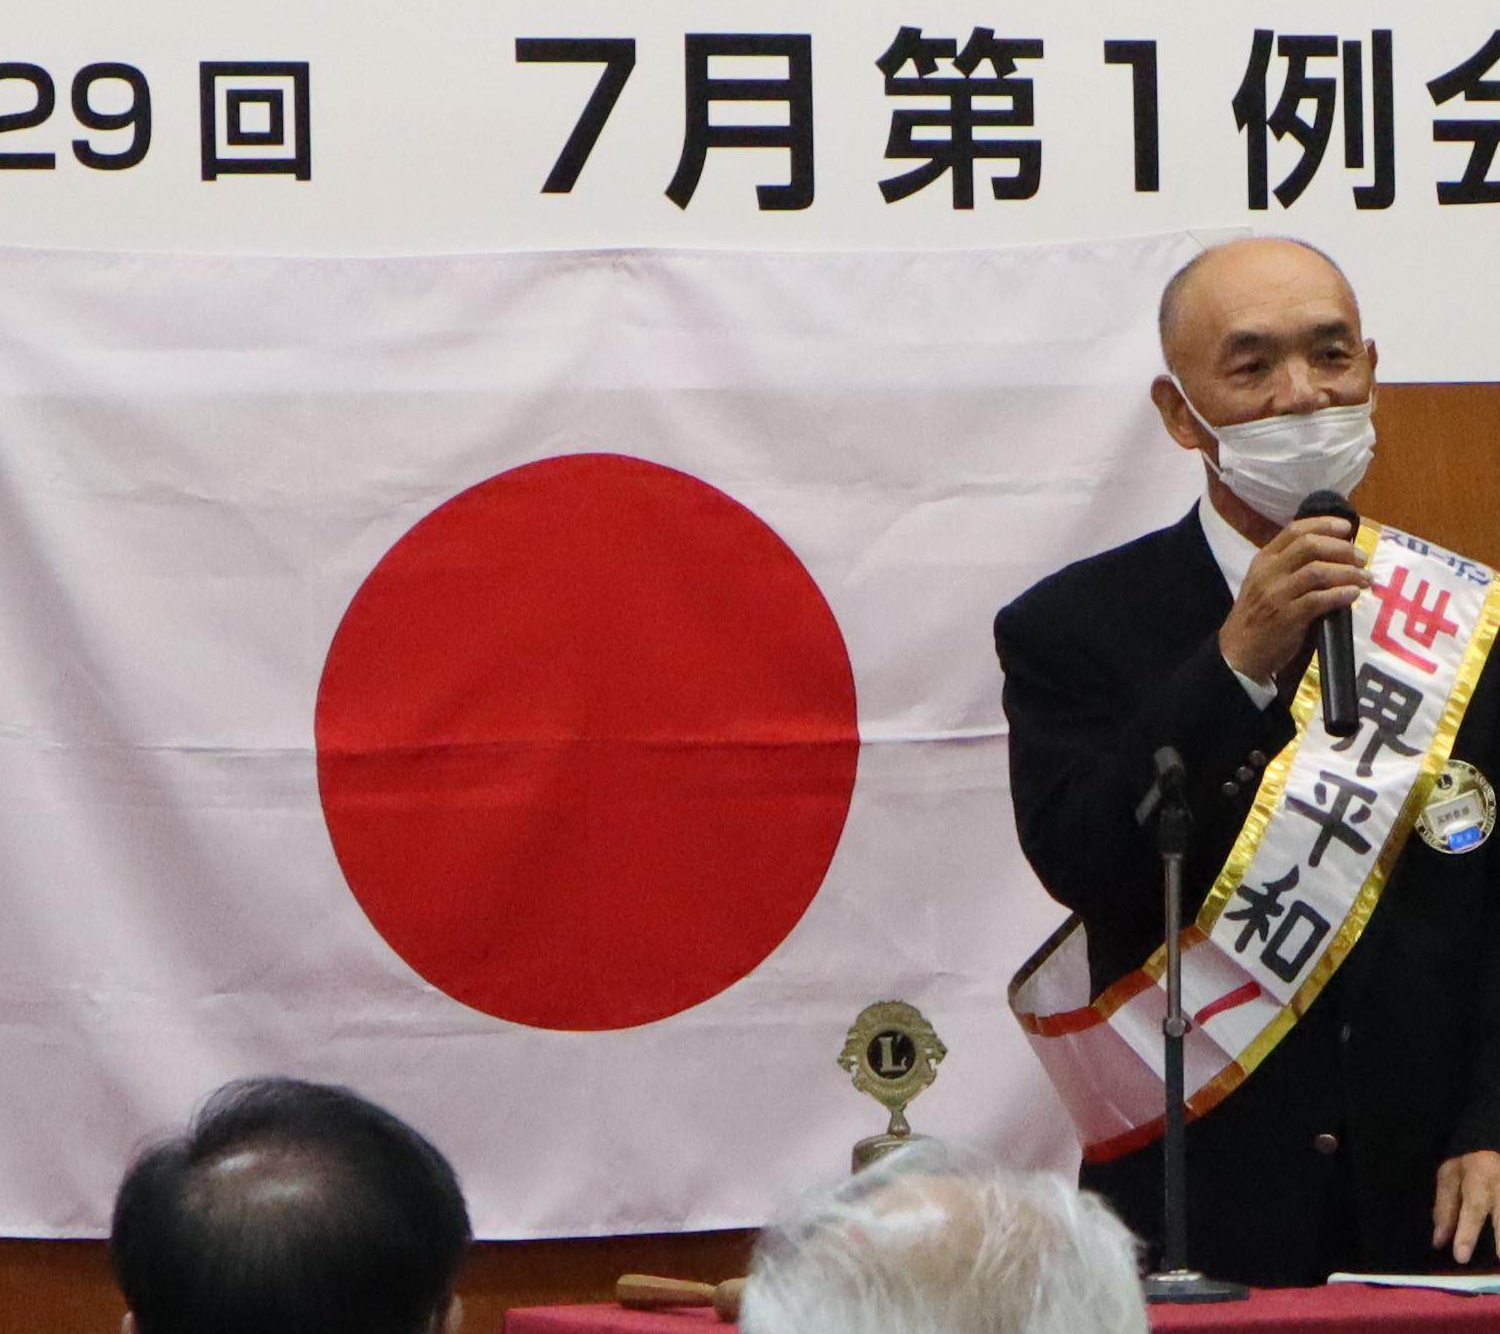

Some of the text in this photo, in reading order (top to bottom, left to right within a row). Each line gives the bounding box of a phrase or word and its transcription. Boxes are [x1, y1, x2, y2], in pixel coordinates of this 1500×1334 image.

[1223, 564, 1460, 984] 世界平和
[878, 1035, 907, 1073] L
